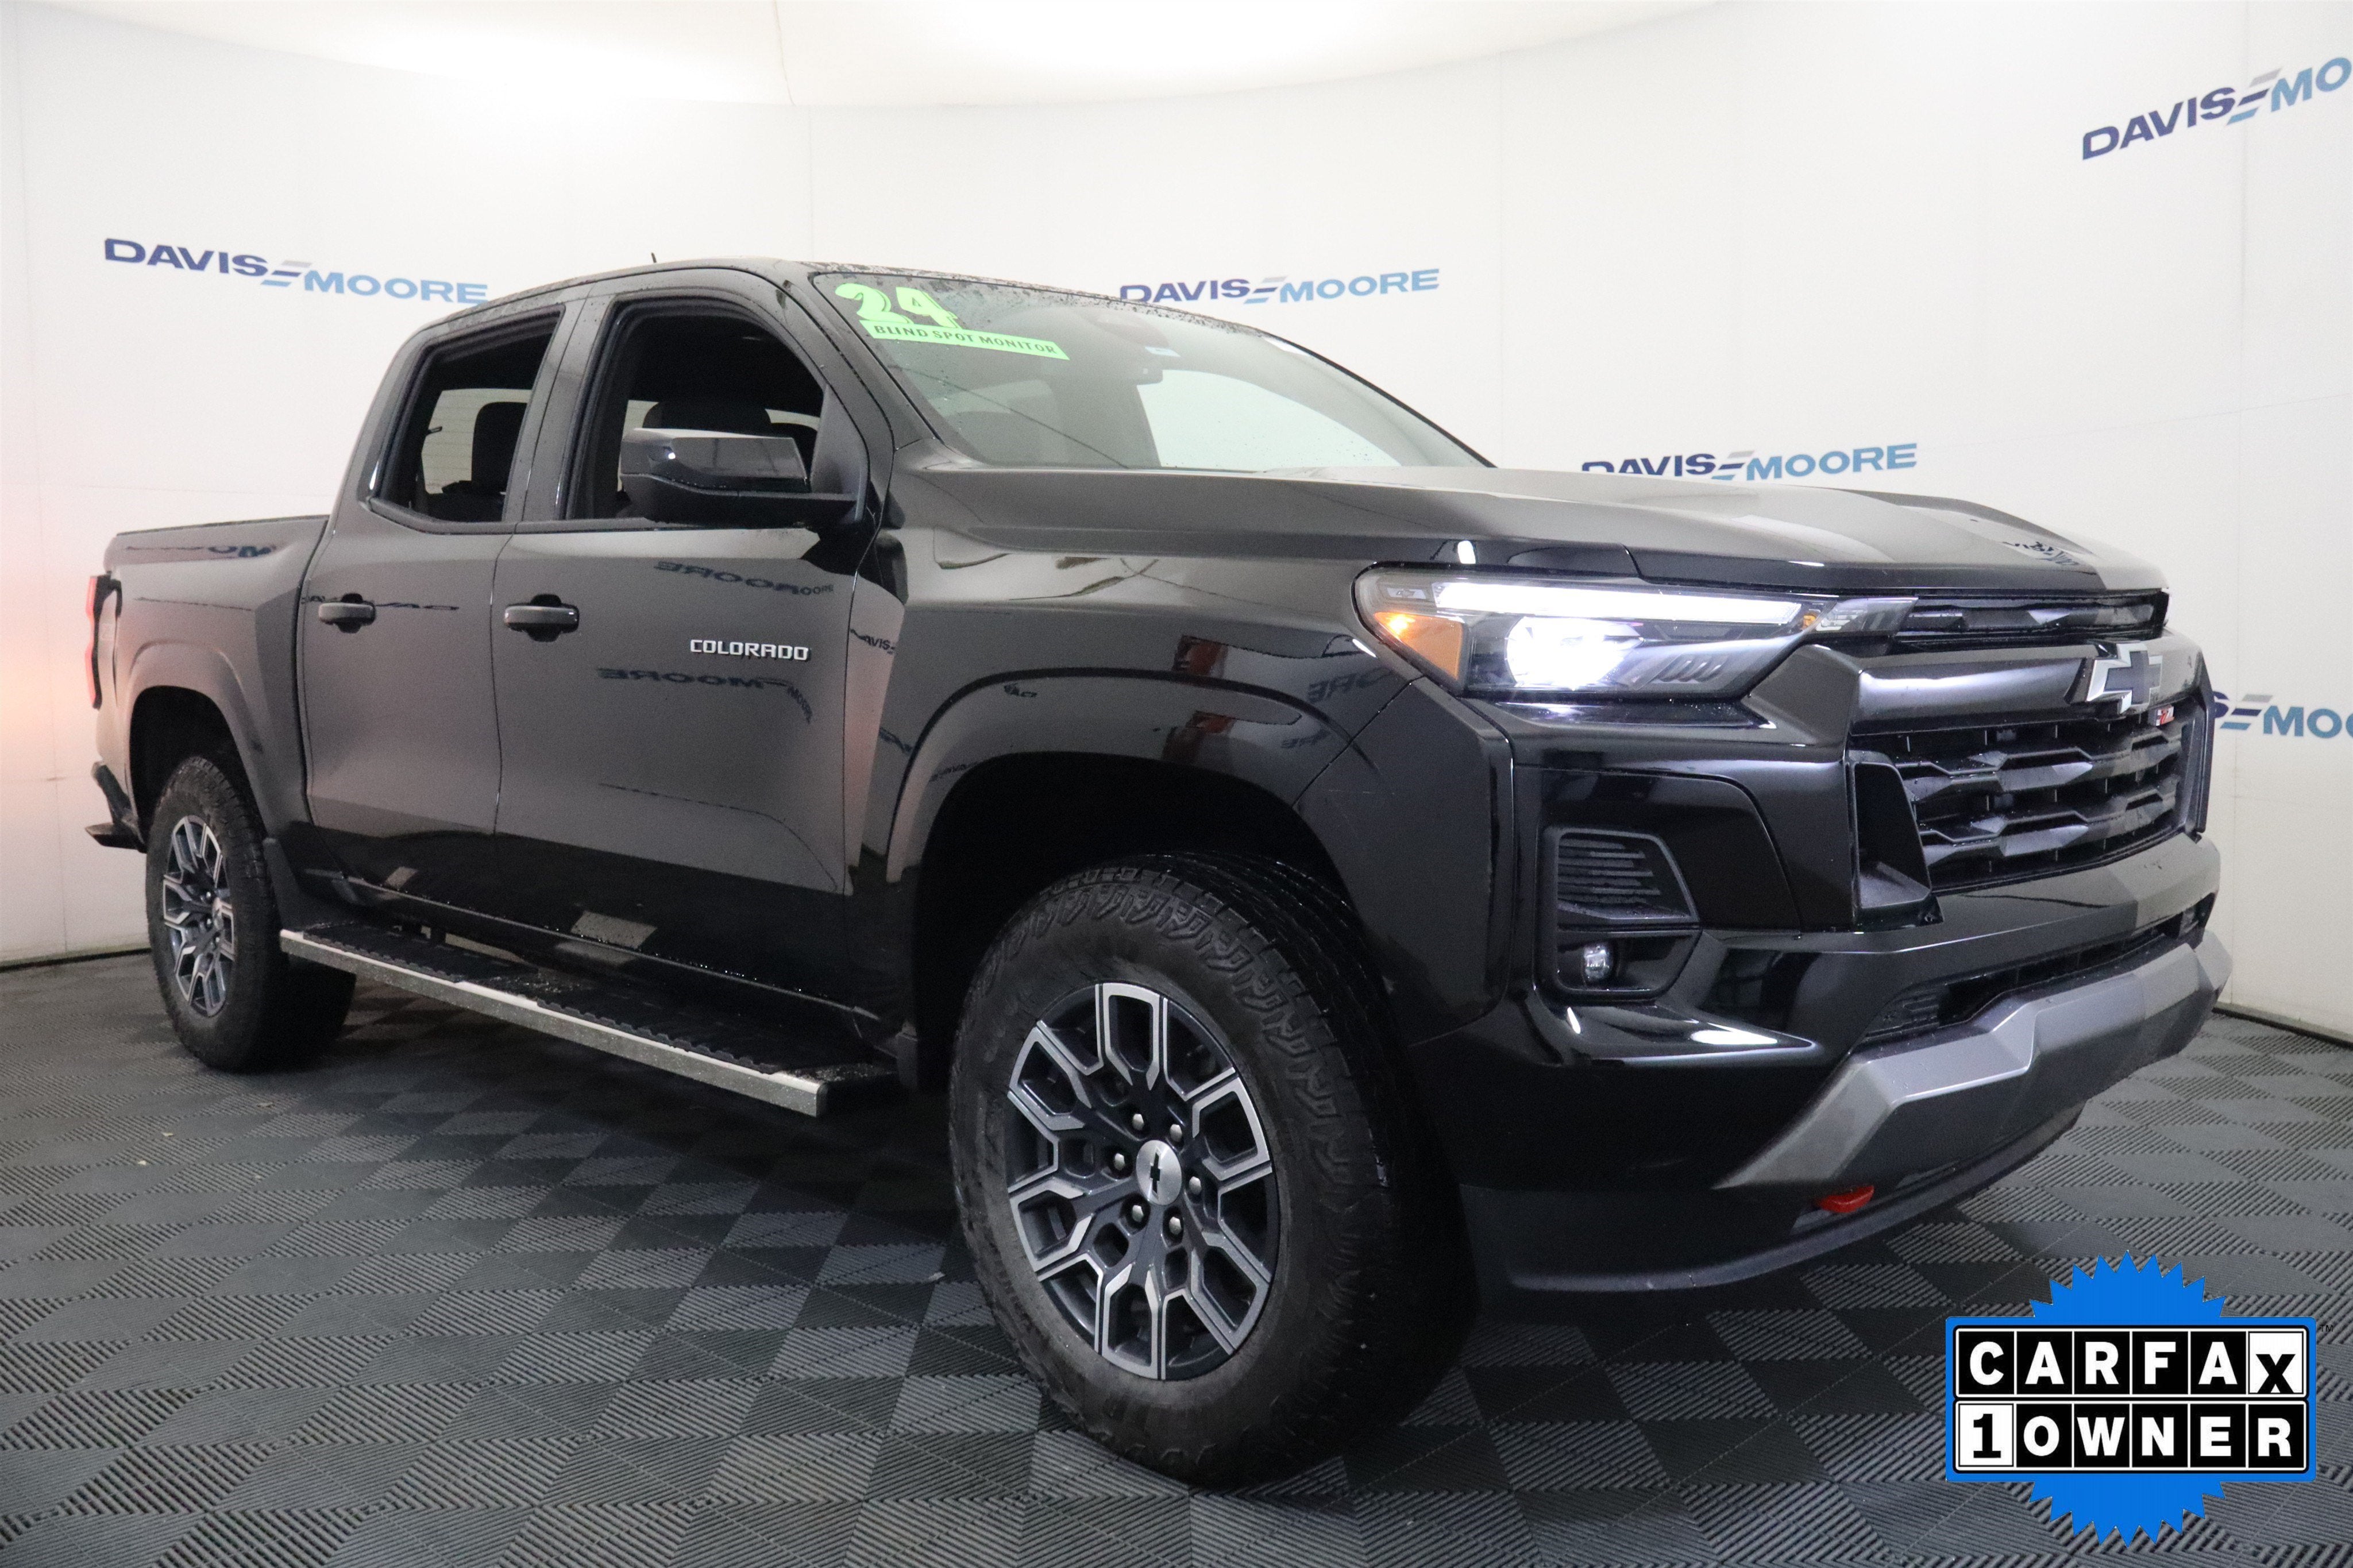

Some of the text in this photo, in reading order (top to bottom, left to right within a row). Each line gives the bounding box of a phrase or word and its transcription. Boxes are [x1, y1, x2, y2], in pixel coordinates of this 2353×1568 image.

[2082, 87, 2235, 160] DAVIS
[104, 238, 488, 306] DAVIS MOORE
[1120, 268, 1440, 303] DAVIS MOORE
[835, 283, 963, 329] 24
[874, 325, 1058, 354] BLIND SPOT MONITOR
[1746, 443, 1918, 481] MOORE
[690, 639, 809, 661] COLORADO
[2263, 706, 2353, 739] MO
